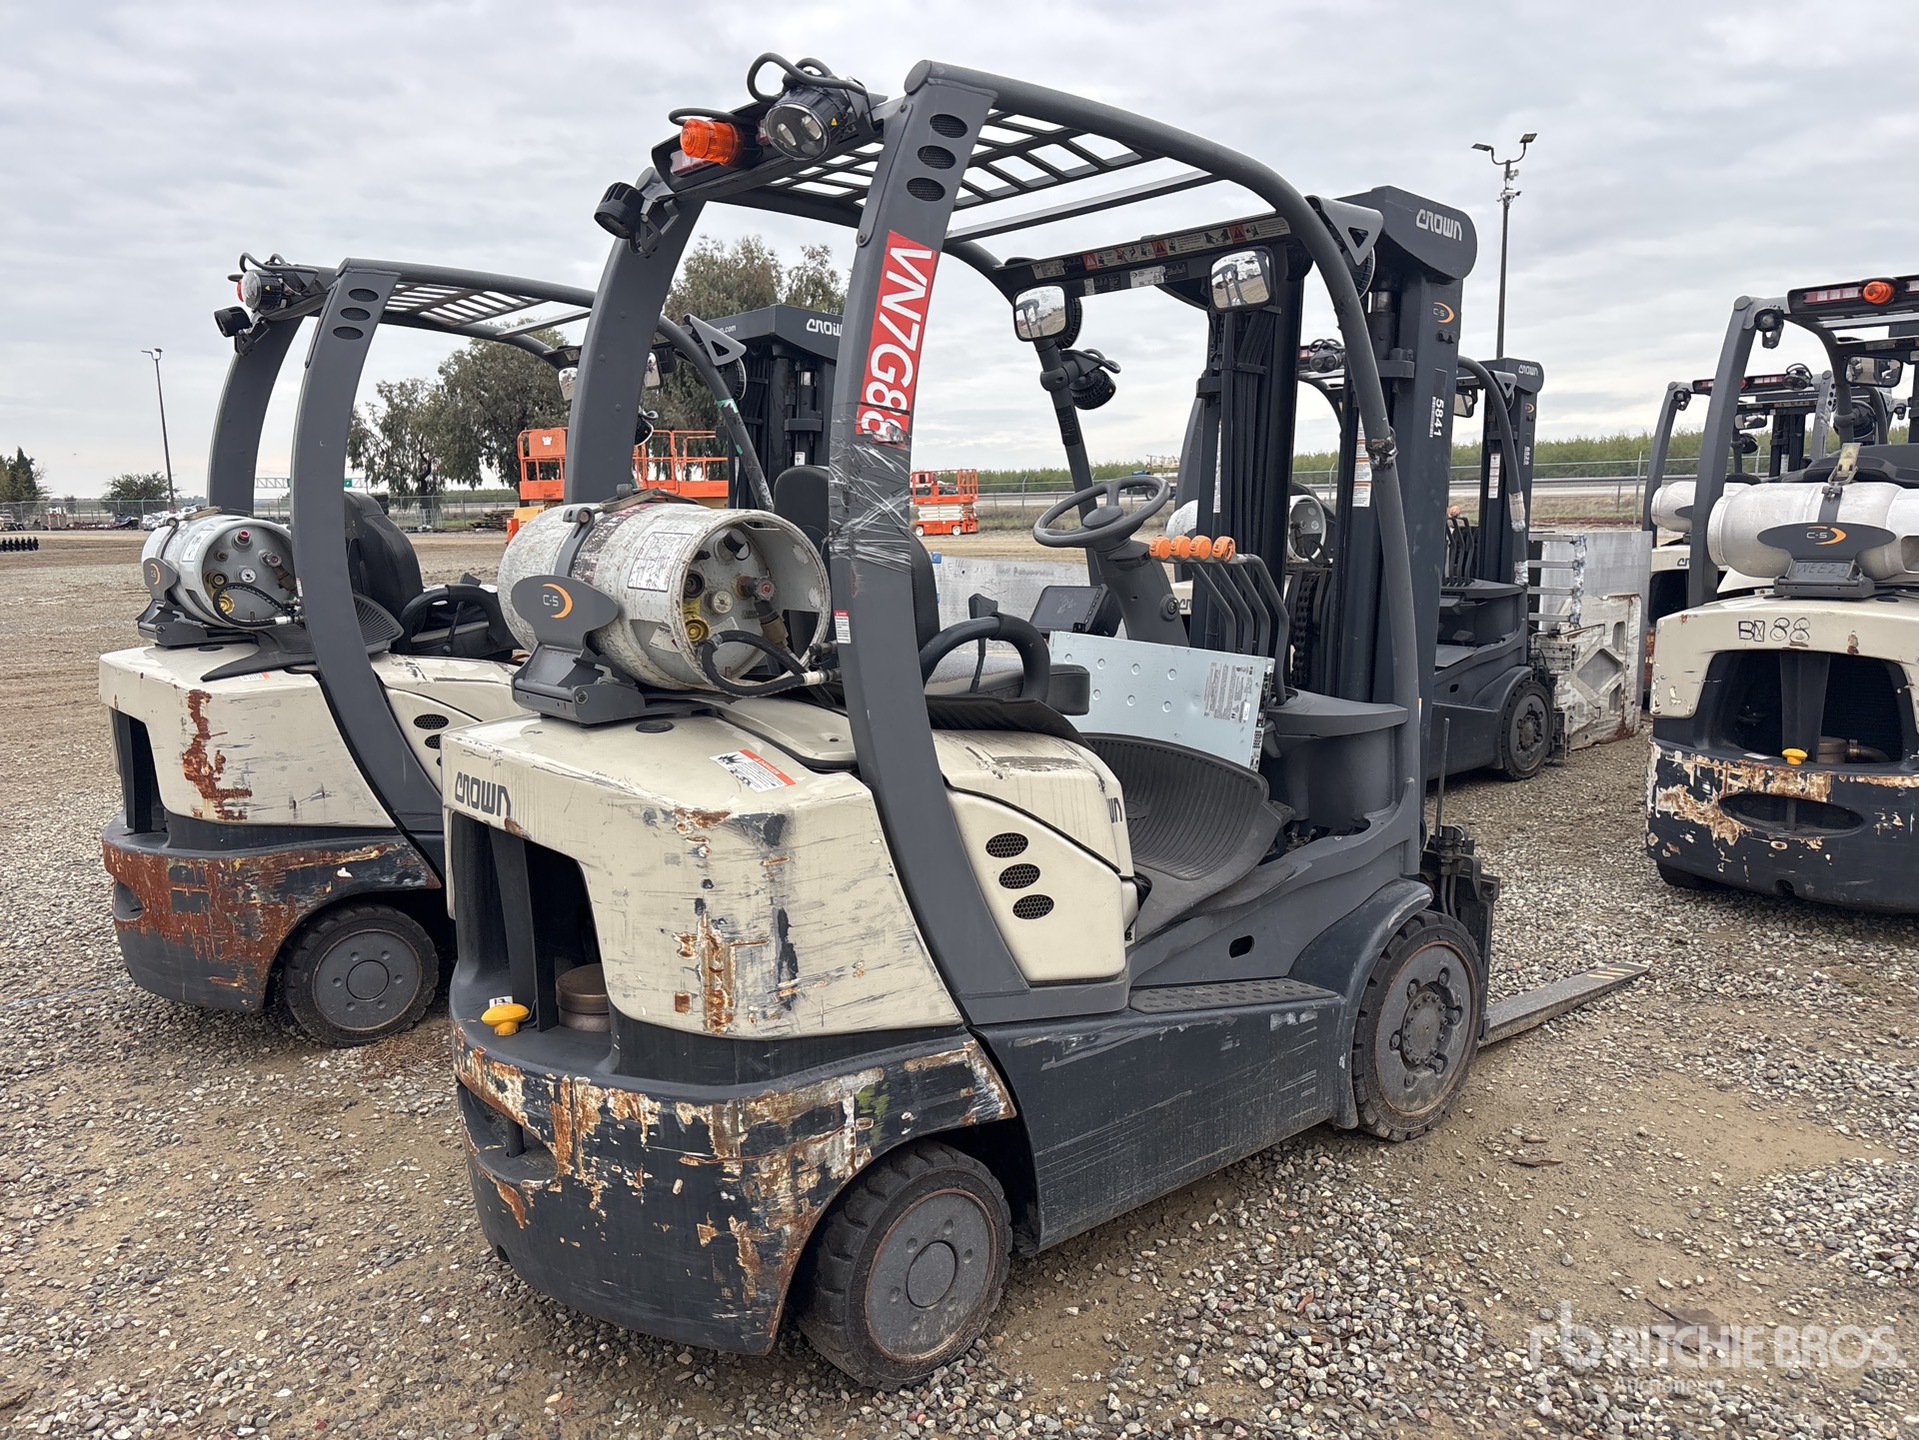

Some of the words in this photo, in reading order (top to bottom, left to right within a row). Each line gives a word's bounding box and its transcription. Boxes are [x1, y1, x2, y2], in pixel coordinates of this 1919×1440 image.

[1415, 208, 1463, 242] CROWN
[806, 318, 843, 337] CROW
[1433, 398, 1445, 437] 5841
[455, 771, 512, 818] CROWN
